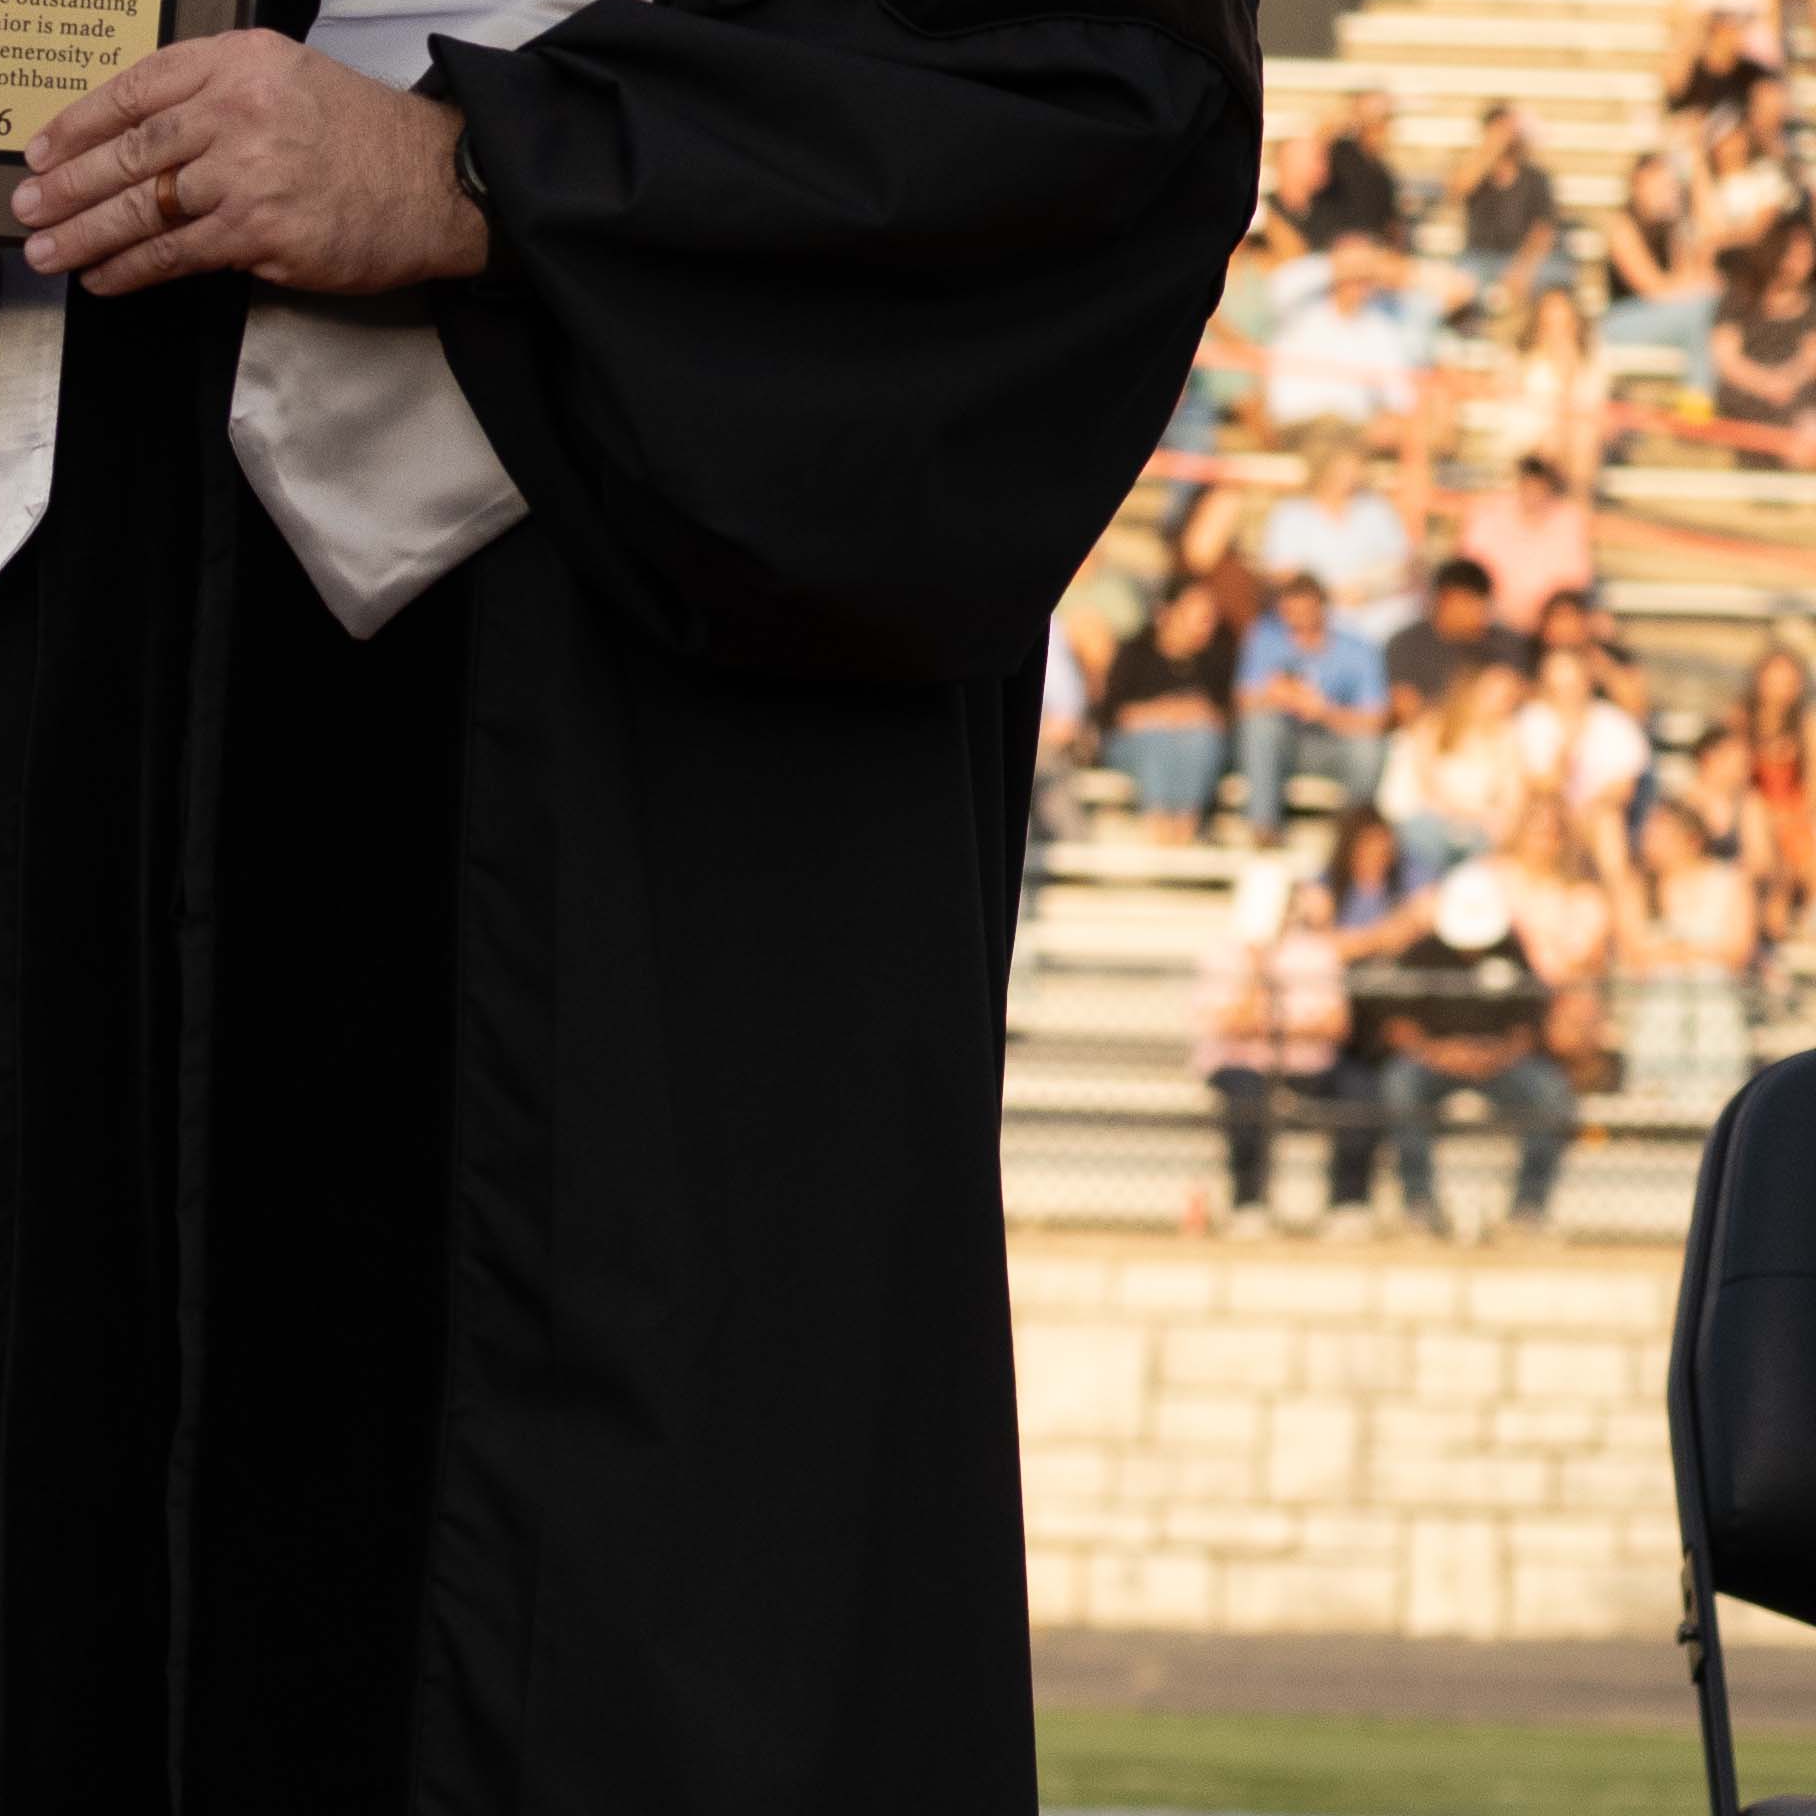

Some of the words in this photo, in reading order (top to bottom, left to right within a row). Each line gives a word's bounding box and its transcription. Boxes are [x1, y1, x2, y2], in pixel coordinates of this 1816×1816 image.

[37, 15, 53, 34] is
[59, 18, 116, 38] made
[99, 46, 122, 66] of
